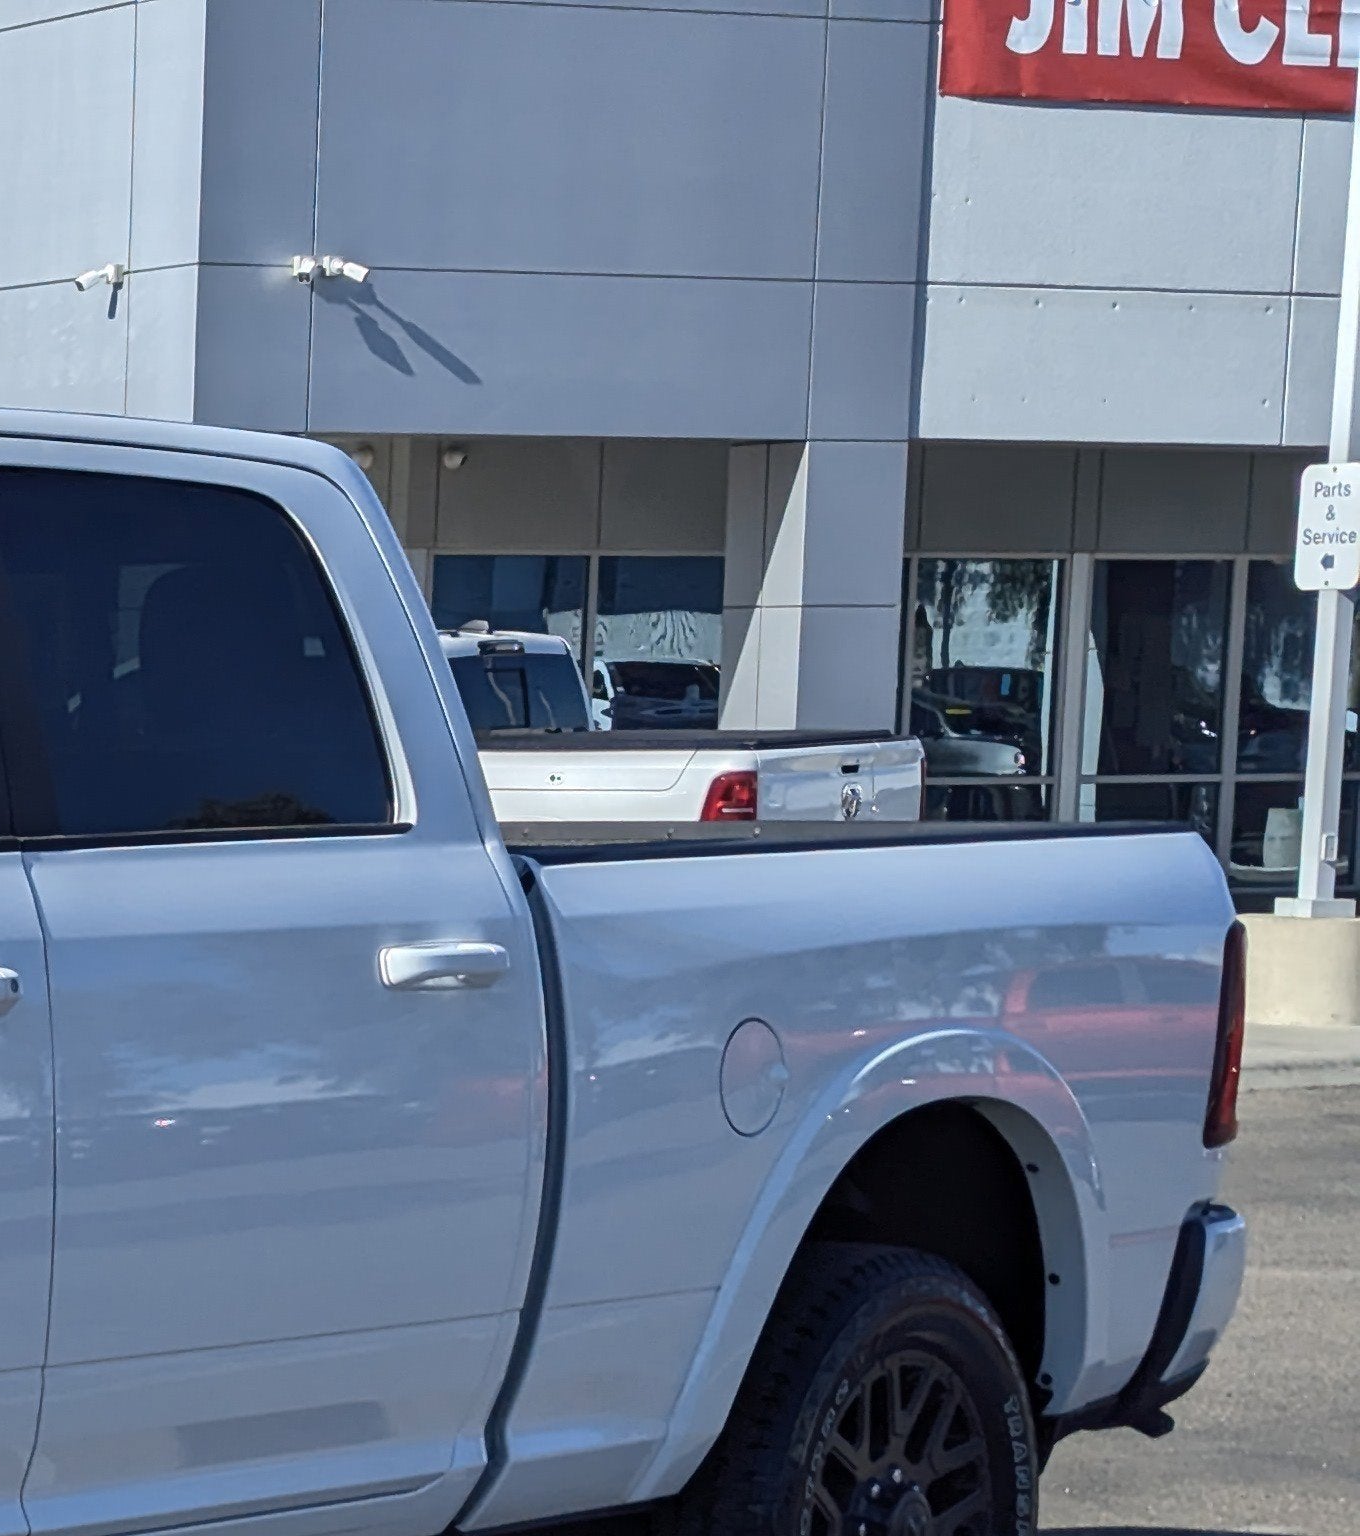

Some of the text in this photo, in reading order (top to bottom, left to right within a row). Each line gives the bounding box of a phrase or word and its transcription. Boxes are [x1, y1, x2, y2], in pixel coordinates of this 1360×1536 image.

[1314, 481, 1352, 498] Parts
[1325, 504, 1336, 521] &
[1302, 527, 1358, 546] Service
